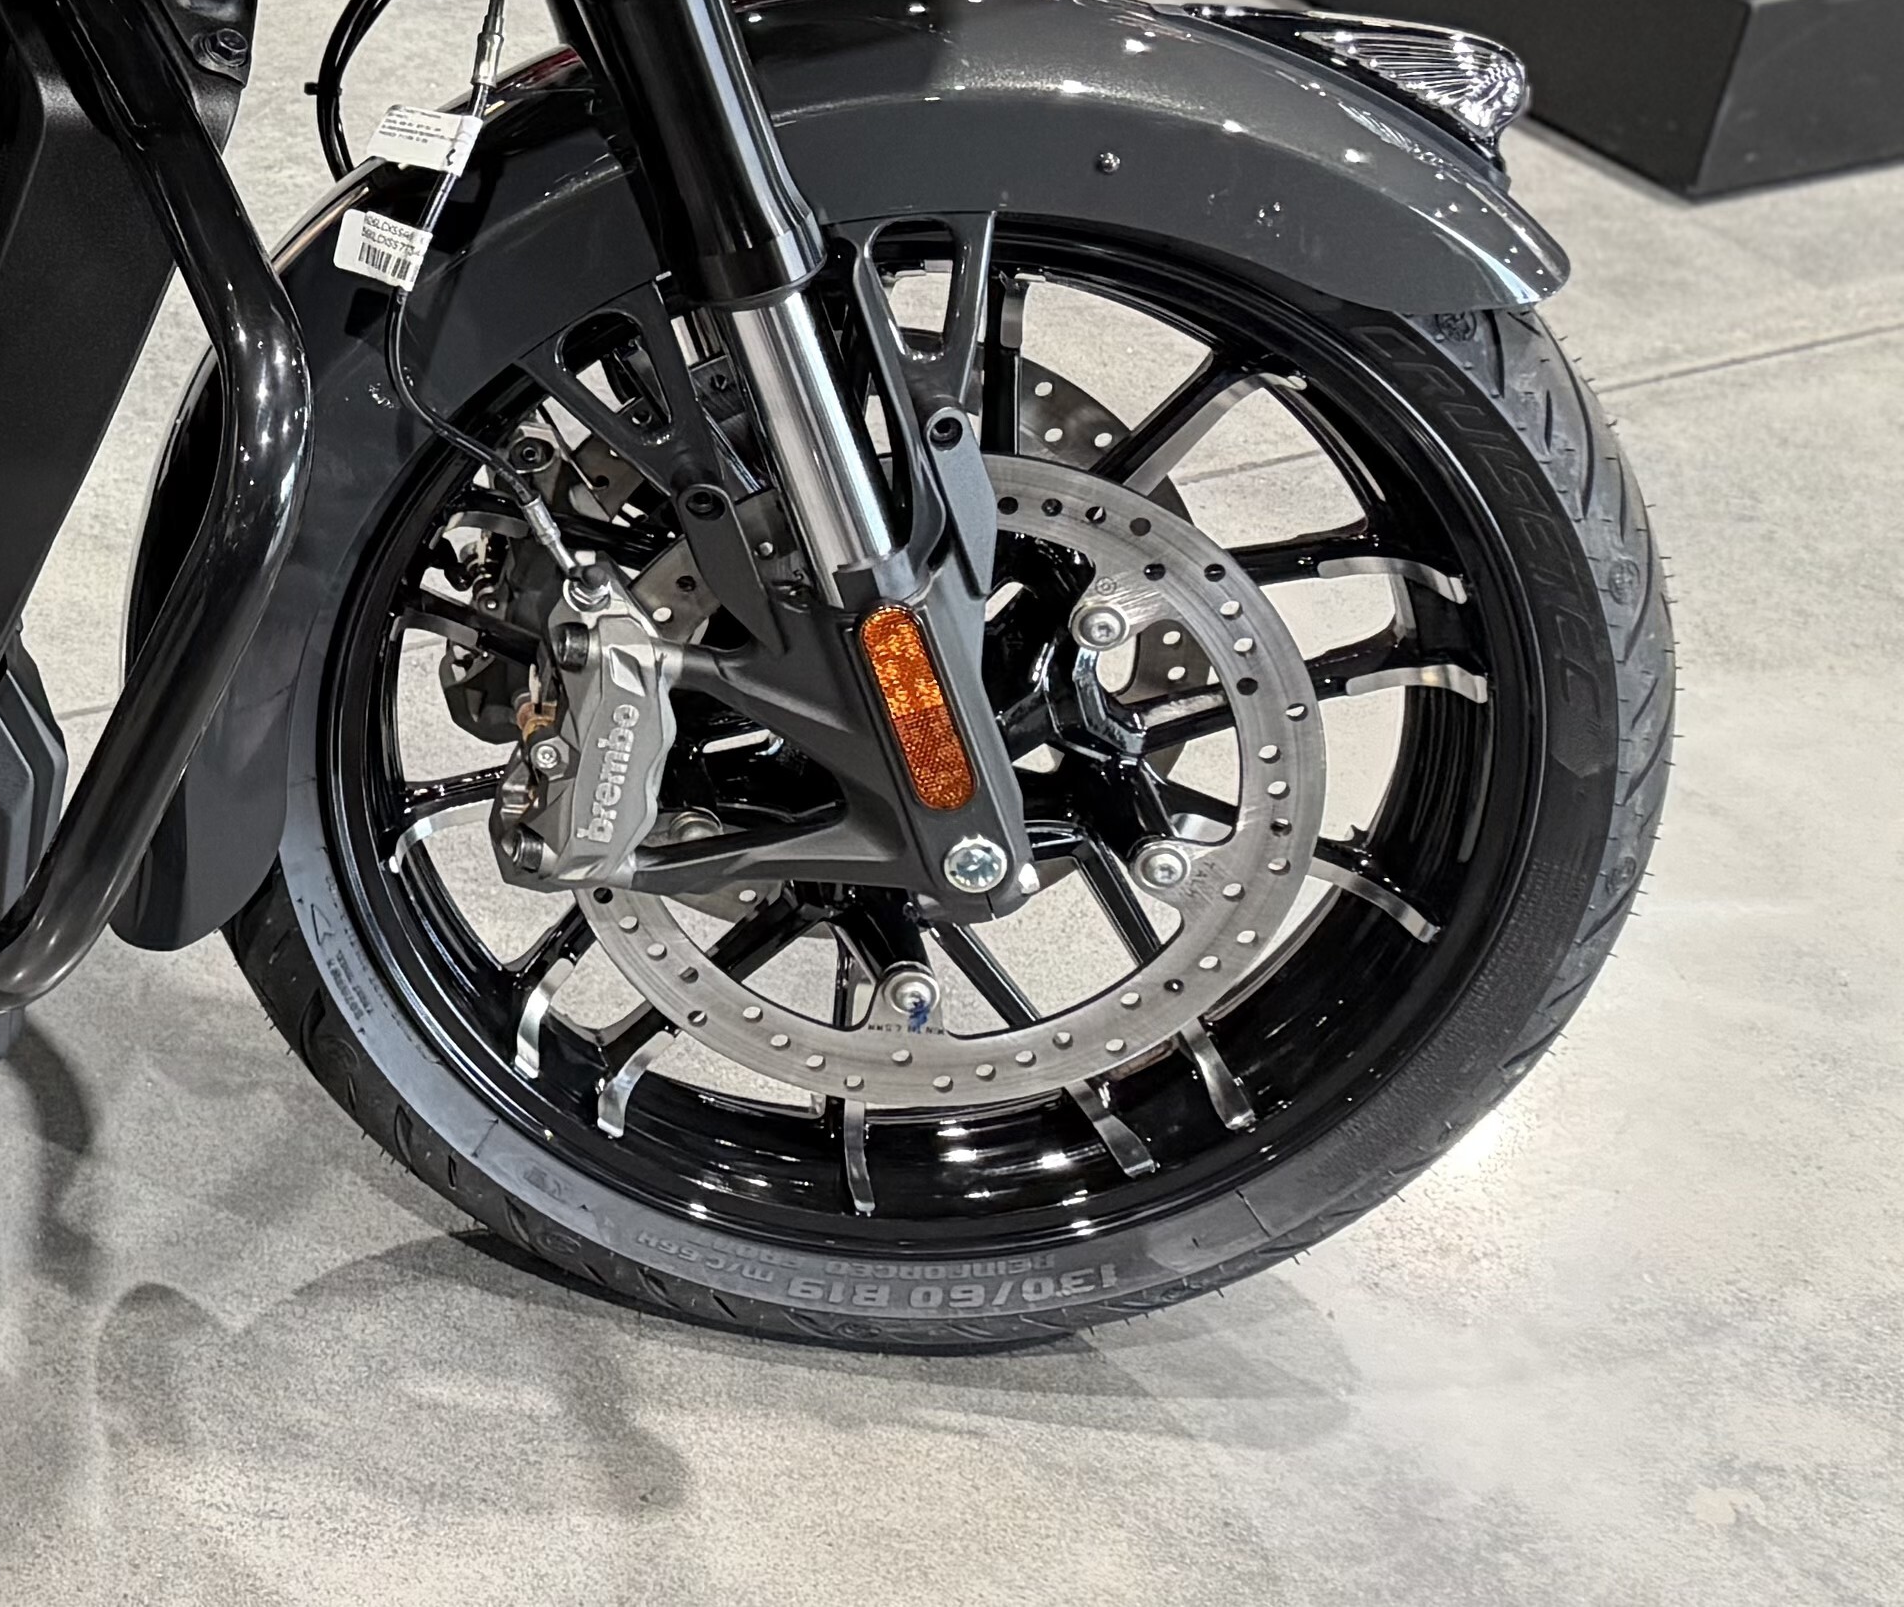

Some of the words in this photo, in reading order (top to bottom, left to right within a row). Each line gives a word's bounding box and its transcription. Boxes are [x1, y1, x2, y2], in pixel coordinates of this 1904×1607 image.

[576, 703, 640, 843] brembo
[823, 1253, 1055, 1279] REINFORCED
[909, 1263, 1116, 1309] 130/60
